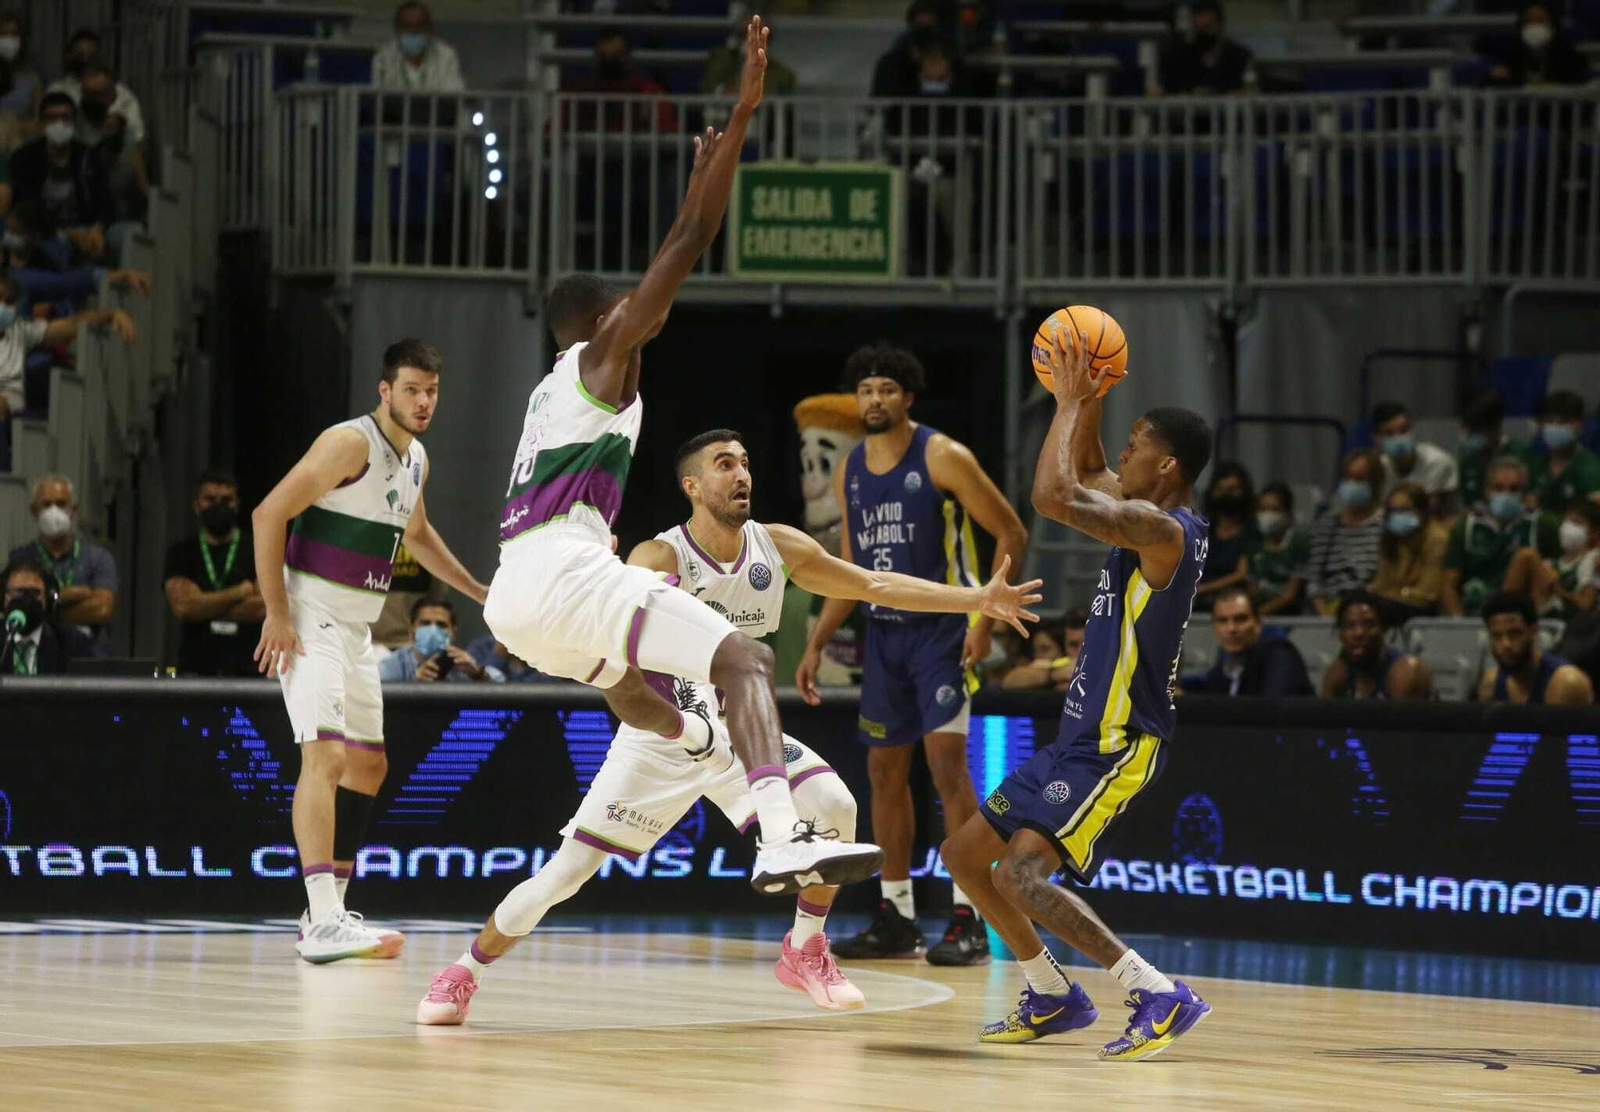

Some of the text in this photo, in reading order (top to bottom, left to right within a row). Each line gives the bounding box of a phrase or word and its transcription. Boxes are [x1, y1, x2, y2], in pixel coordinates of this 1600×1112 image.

[752, 187, 877, 220] SALIDA DE
[743, 226, 884, 259] EMERGENCIA
[873, 547, 893, 571] 25
[726, 609, 765, 624] Unicaja
[0, 845, 232, 877] TBALL
[251, 844, 694, 878] CAMPINS
[1075, 859, 1352, 904] ASKETBALL
